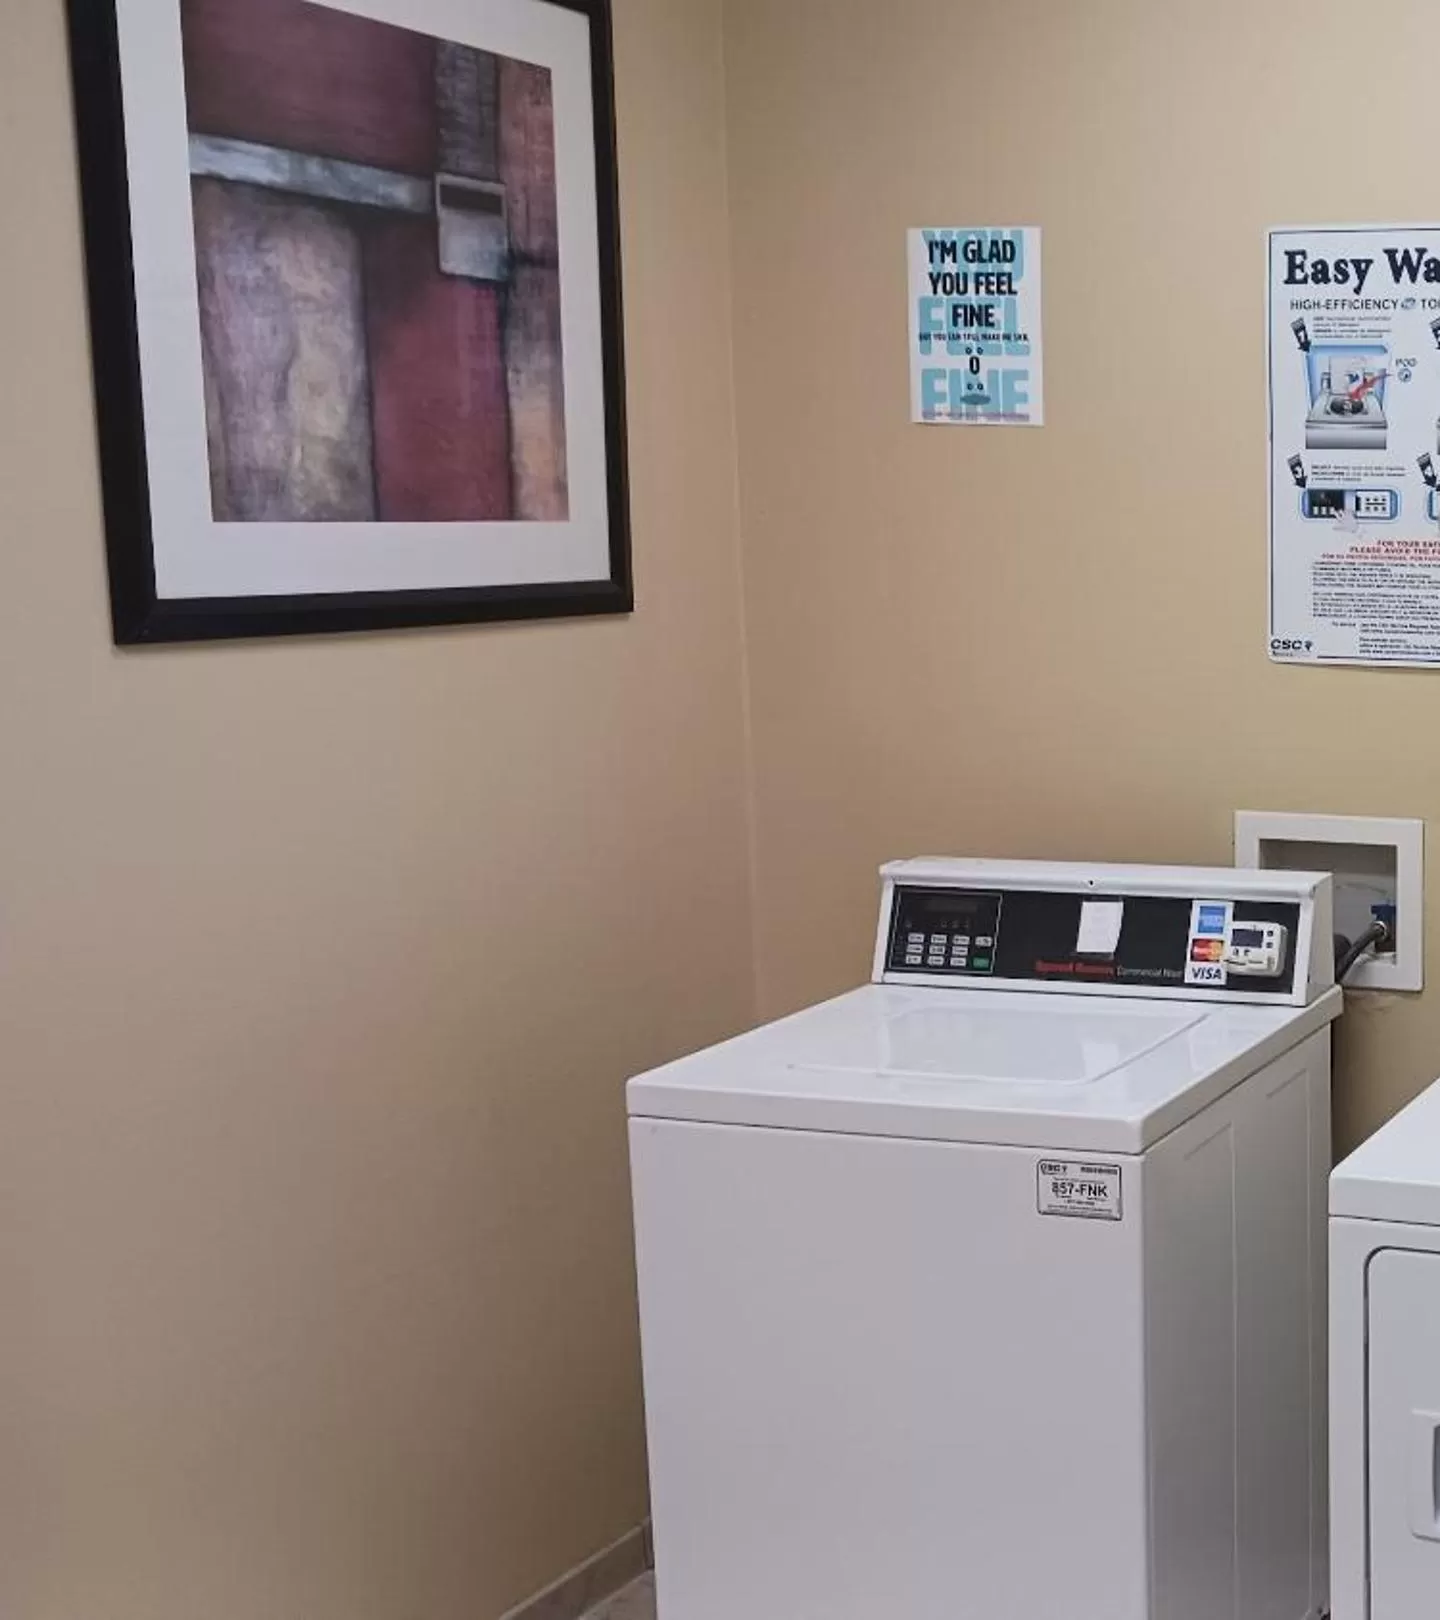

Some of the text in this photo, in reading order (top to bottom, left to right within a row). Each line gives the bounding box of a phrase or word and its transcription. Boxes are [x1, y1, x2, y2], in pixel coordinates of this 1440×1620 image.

[928, 239, 1016, 264] I'M GLAD
[1283, 249, 1374, 295] Easy
[928, 272, 1018, 296] YOU FEEL
[1289, 299, 1398, 311] HIGH-EFFICIENCY
[952, 304, 995, 328] FINE
[1270, 638, 1303, 650] CSC
[1191, 967, 1223, 980] VISA
[1051, 1182, 1108, 1198] 857-FNK
